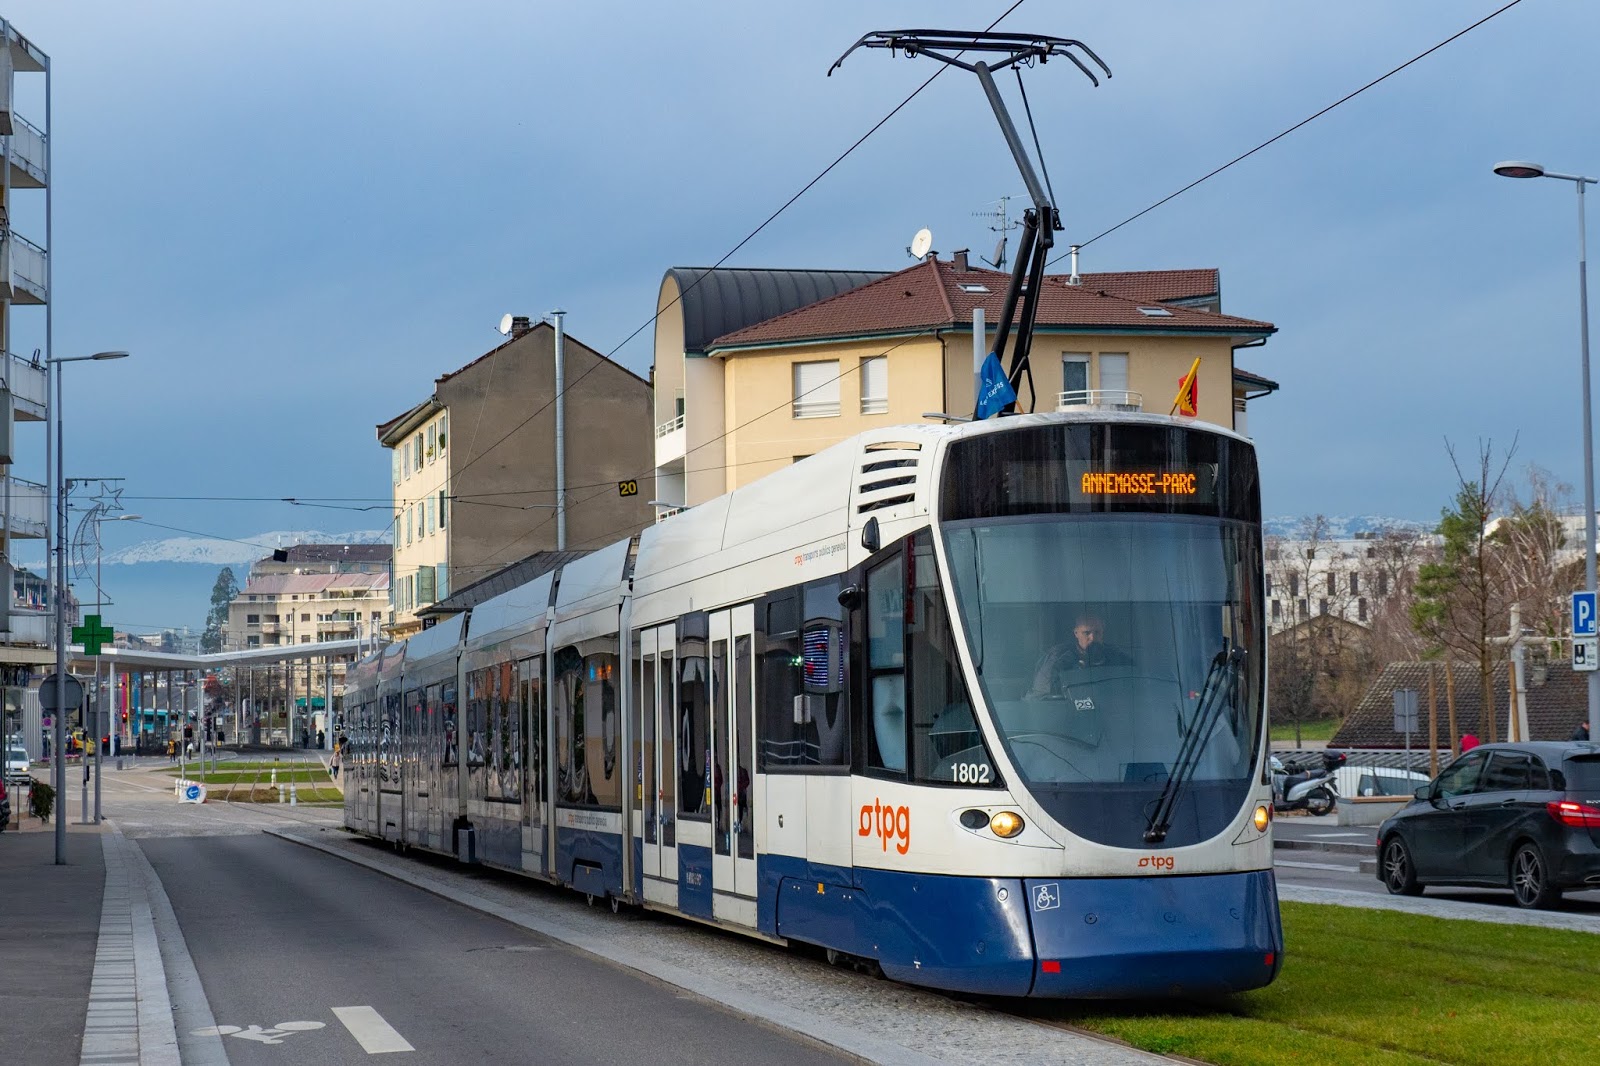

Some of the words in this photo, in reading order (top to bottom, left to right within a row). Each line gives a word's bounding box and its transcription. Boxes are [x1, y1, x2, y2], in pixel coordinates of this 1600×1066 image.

[620, 481, 637, 495] 20
[1082, 473, 1196, 494] ANNEMASSE-PARC
[1579, 600, 1590, 627] P
[1076, 701, 1093, 710] 29
[951, 762, 990, 784] 1802
